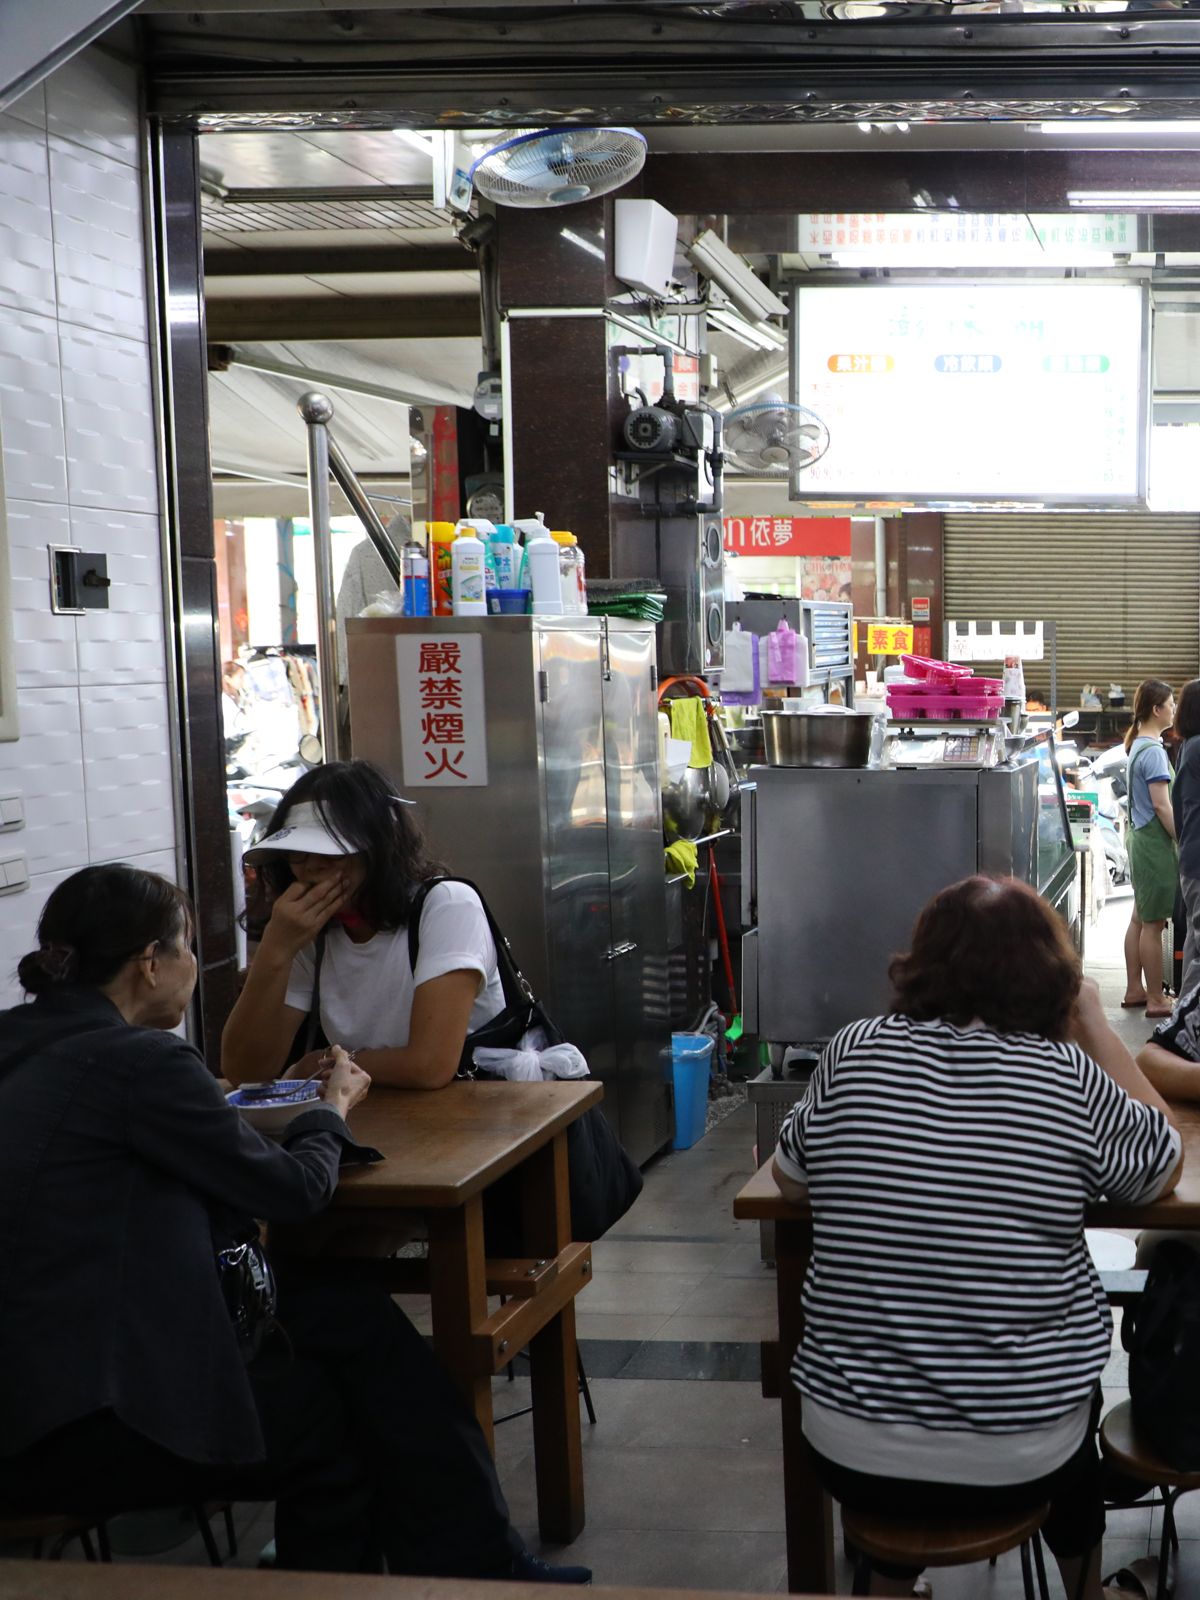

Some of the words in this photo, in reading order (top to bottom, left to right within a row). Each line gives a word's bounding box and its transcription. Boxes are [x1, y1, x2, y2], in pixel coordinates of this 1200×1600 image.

[750, 519, 793, 546] 依夢
[872, 629, 909, 651] 素食
[418, 642, 468, 780] 嚴禁煙火
